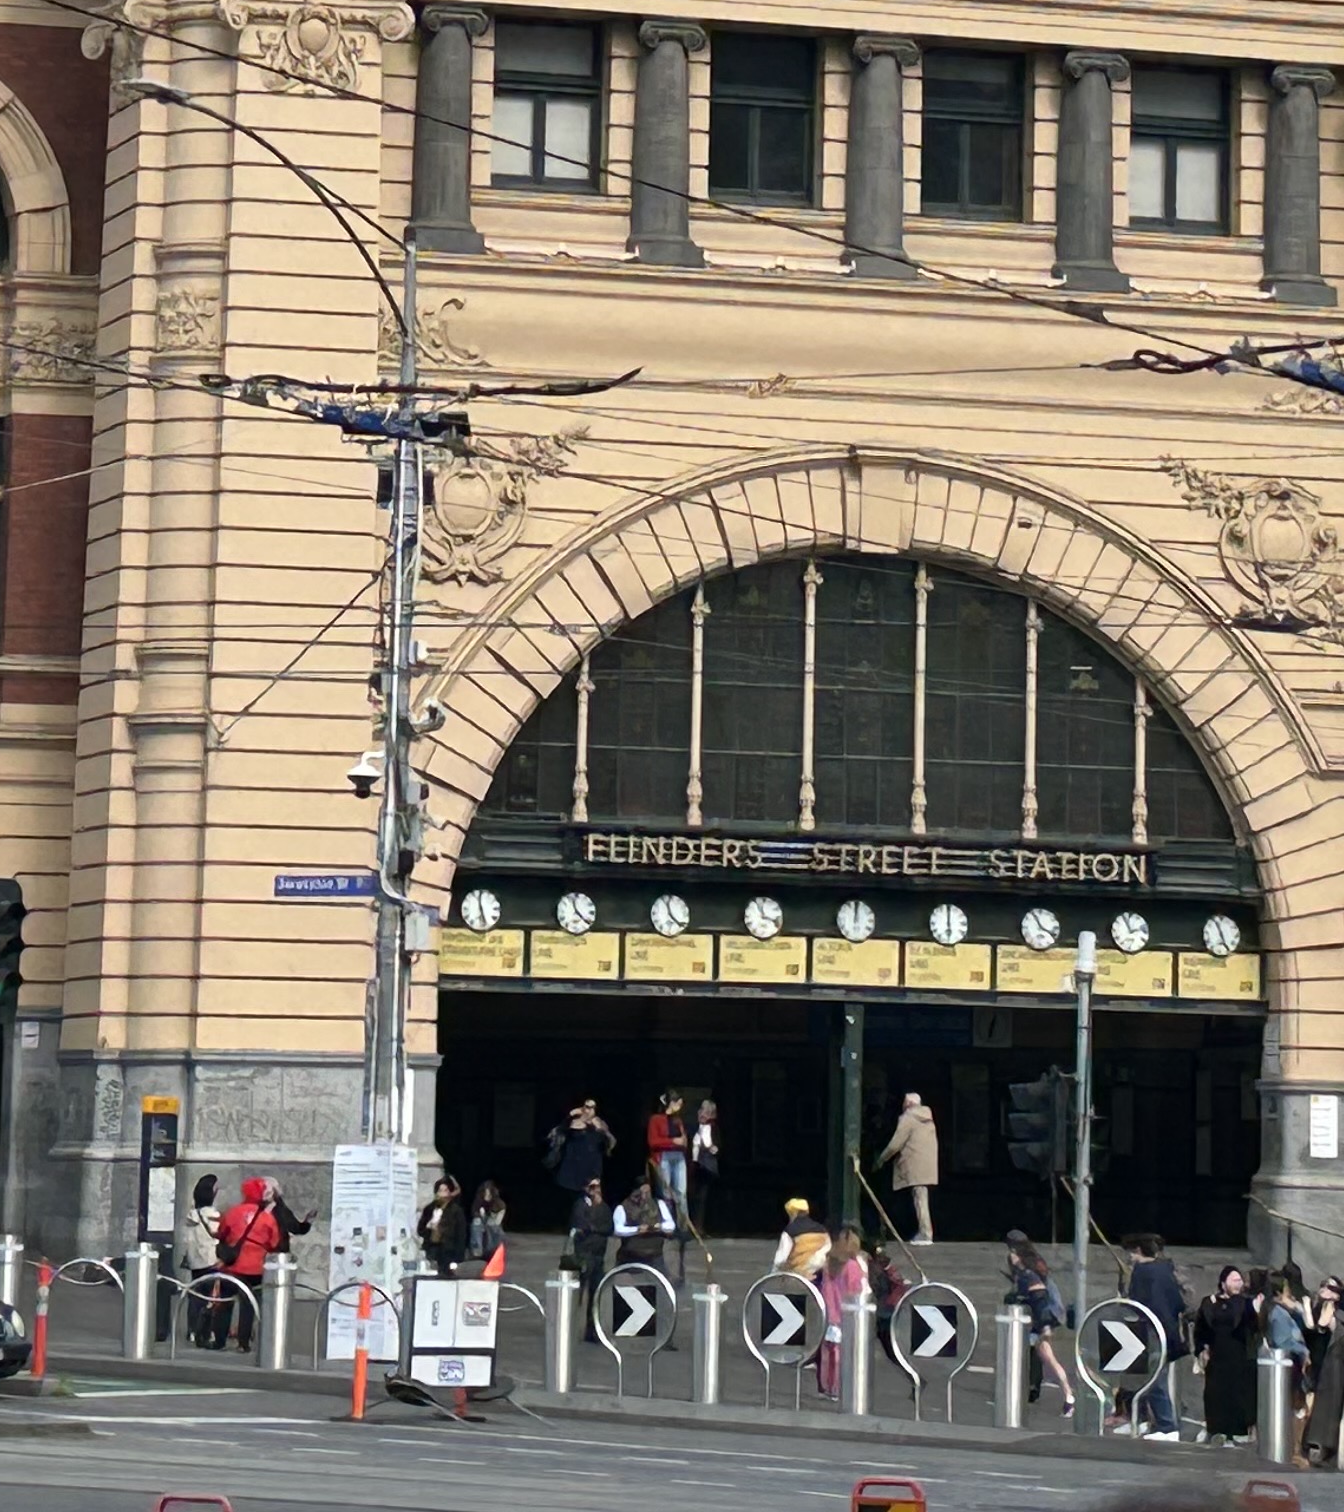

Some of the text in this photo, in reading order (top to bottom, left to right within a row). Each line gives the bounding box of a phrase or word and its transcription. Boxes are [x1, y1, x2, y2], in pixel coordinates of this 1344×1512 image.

[584, 833, 1148, 885] FLINDERS STREET STATION
